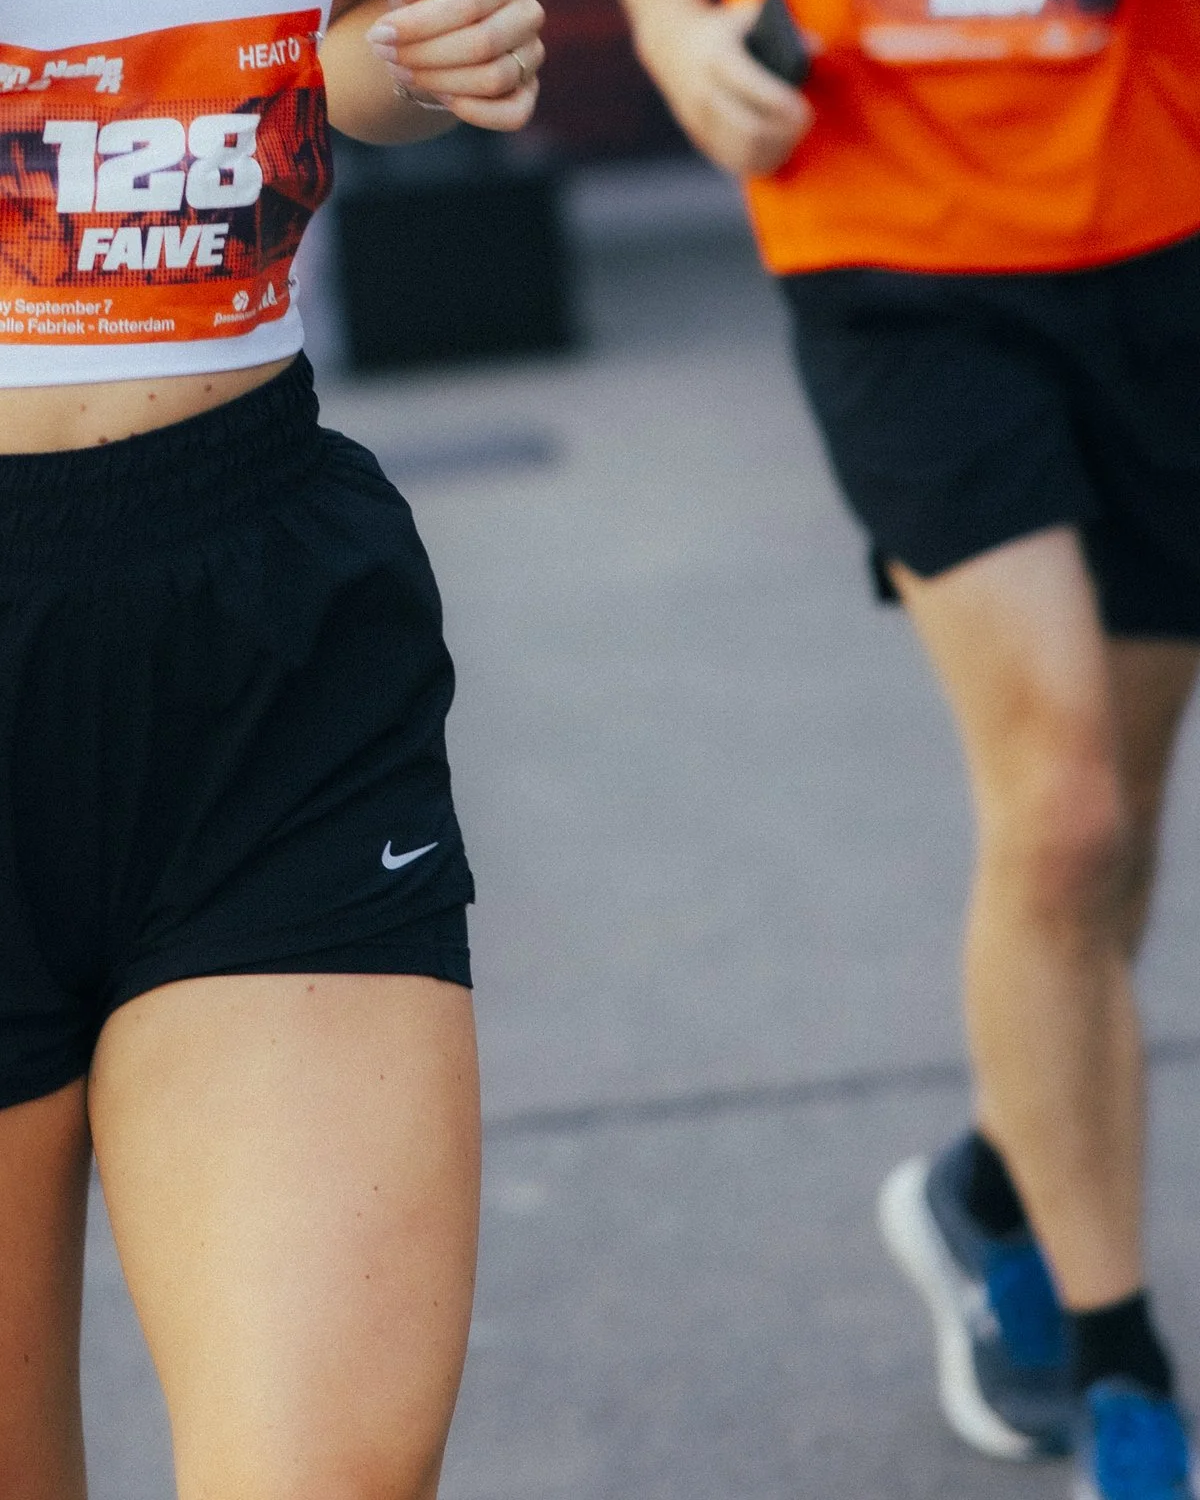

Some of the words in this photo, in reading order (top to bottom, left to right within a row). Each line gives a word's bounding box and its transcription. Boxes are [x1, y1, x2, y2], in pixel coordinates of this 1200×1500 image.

[238, 39, 287, 71] HEAT
[42, 113, 264, 214] 128
[77, 223, 230, 272] FAIVE
[15, 298, 102, 316] September
[103, 299, 113, 314] 7
[28, 318, 85, 334] Fabriek
[98, 318, 175, 334] Rotterdam
